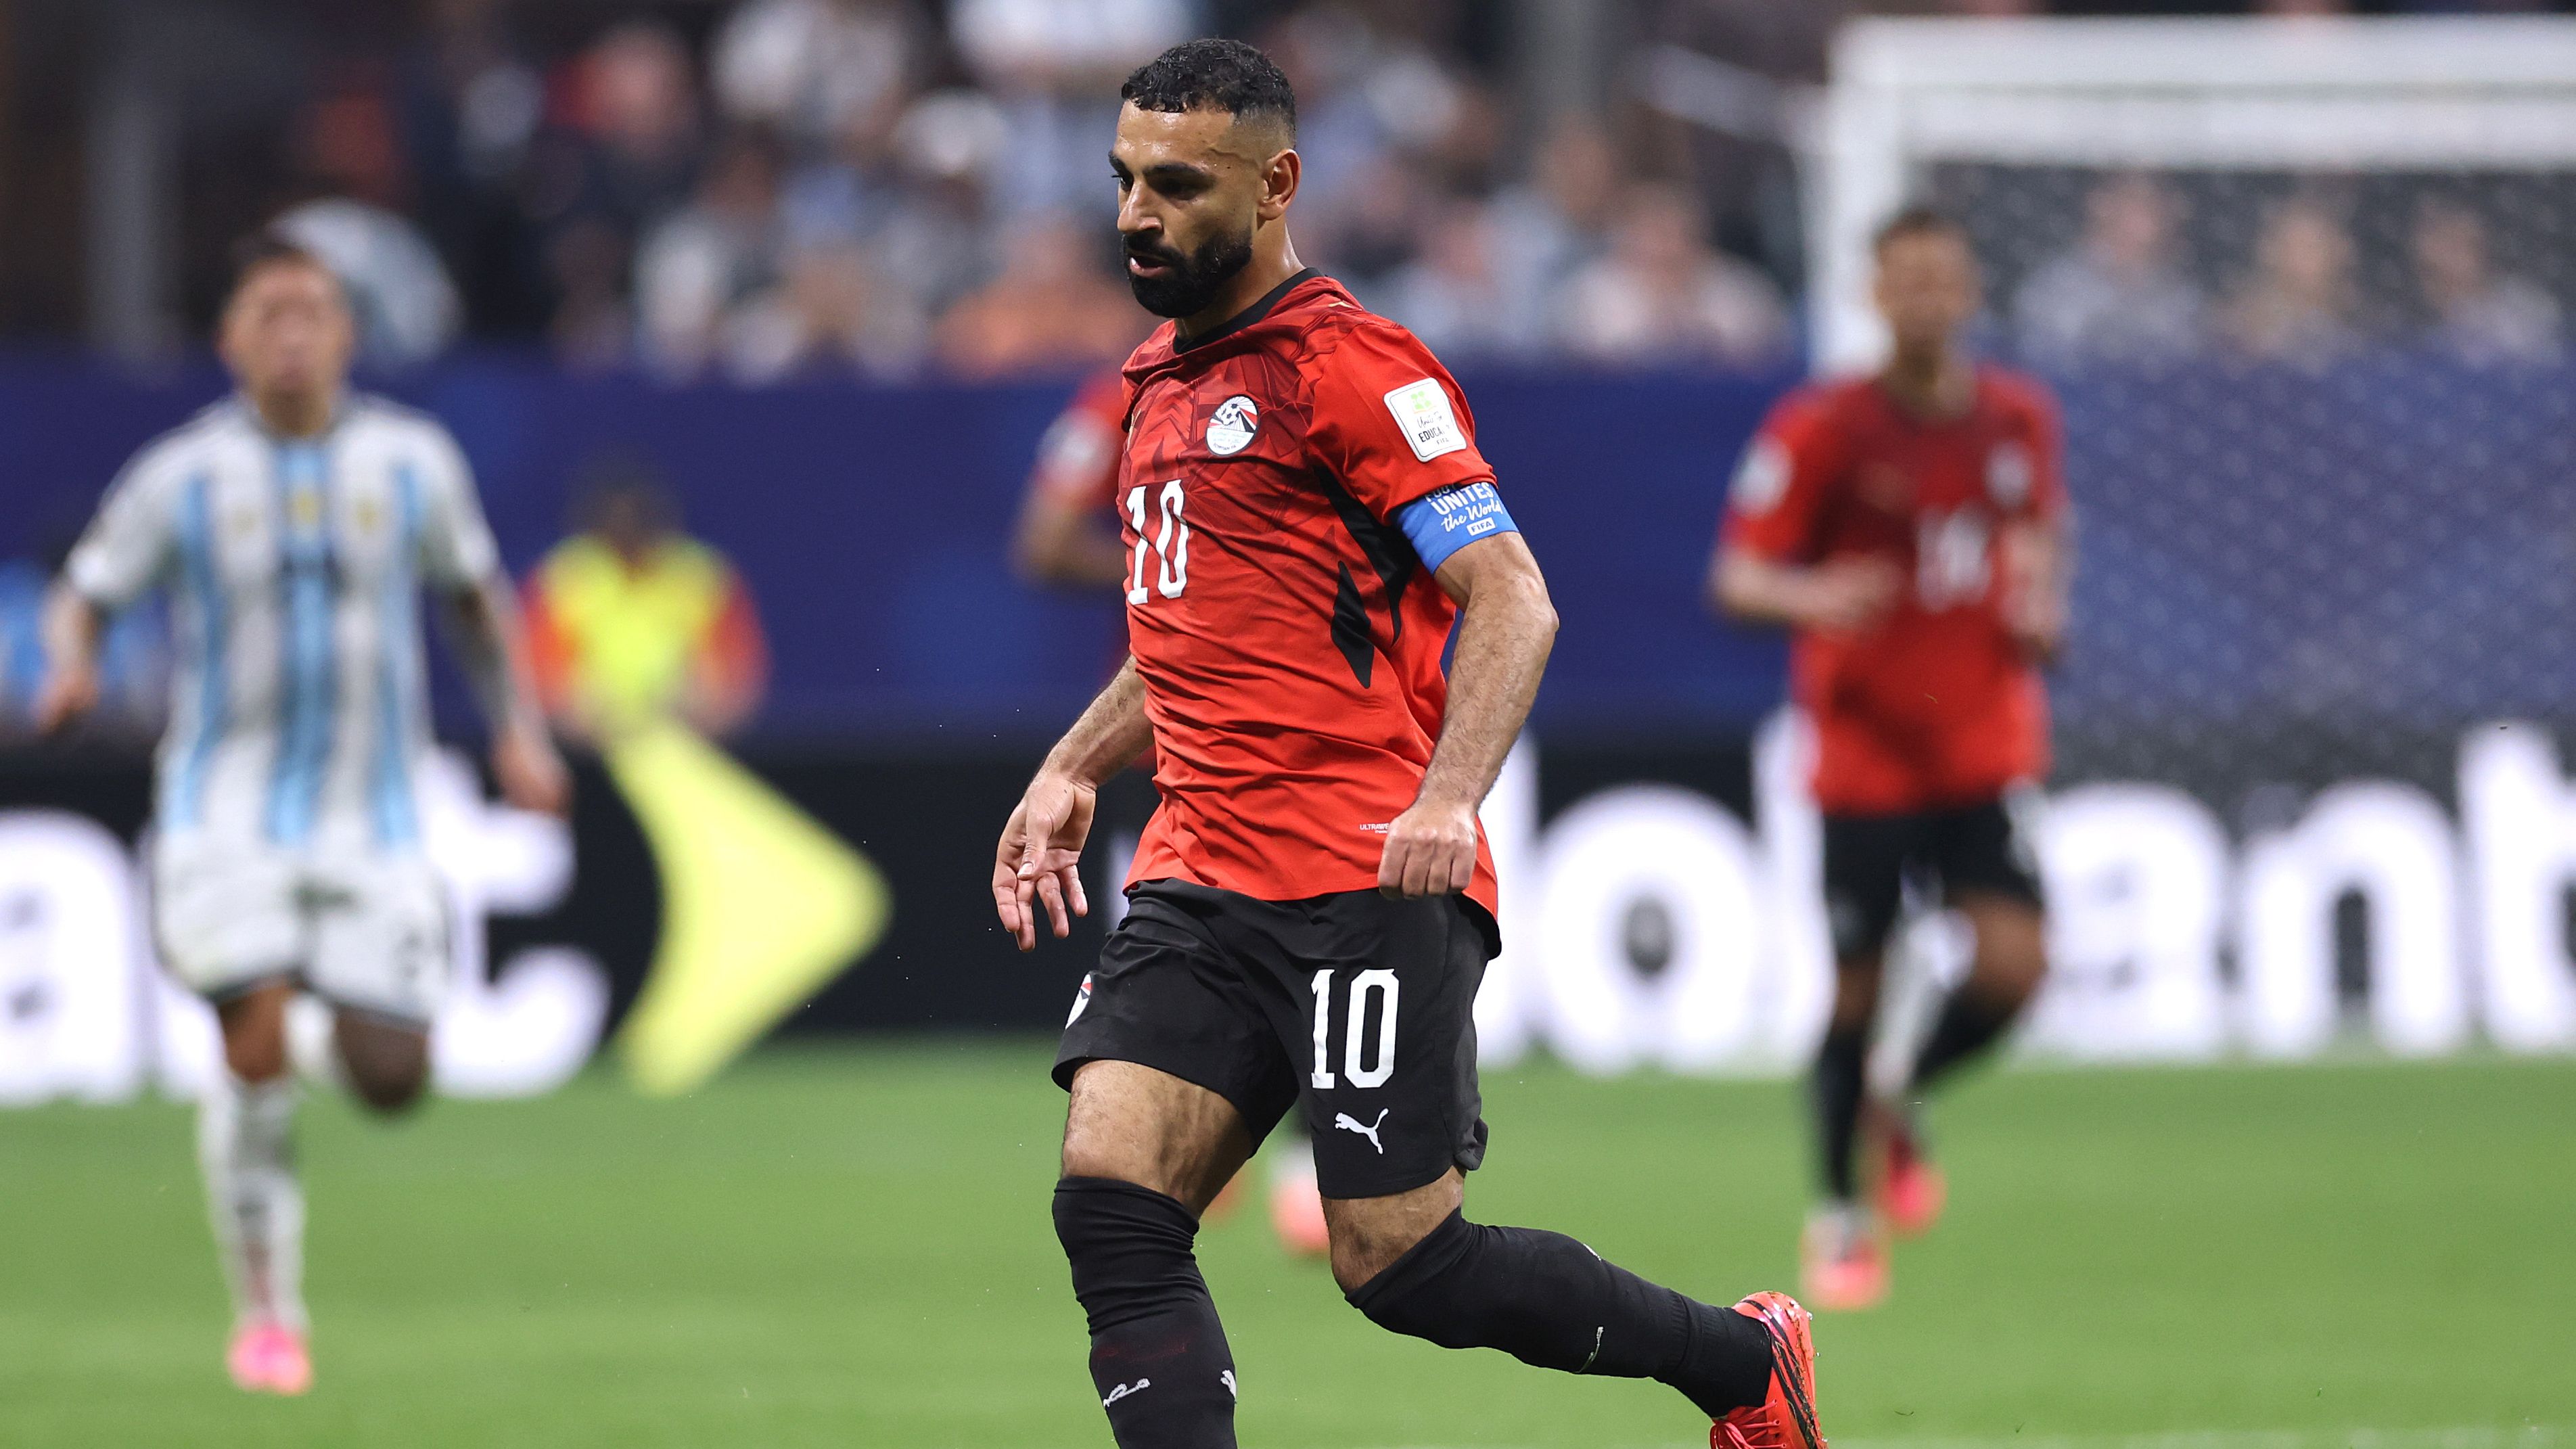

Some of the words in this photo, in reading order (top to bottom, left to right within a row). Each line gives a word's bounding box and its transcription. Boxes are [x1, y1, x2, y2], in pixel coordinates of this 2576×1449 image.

[1430, 482, 1494, 515] UNITES
[1440, 513, 1467, 532] the
[1465, 498, 1503, 521] World
[1126, 478, 1189, 605] 10
[1470, 520, 1493, 533] FIFA
[1310, 967, 1400, 1089] 10
